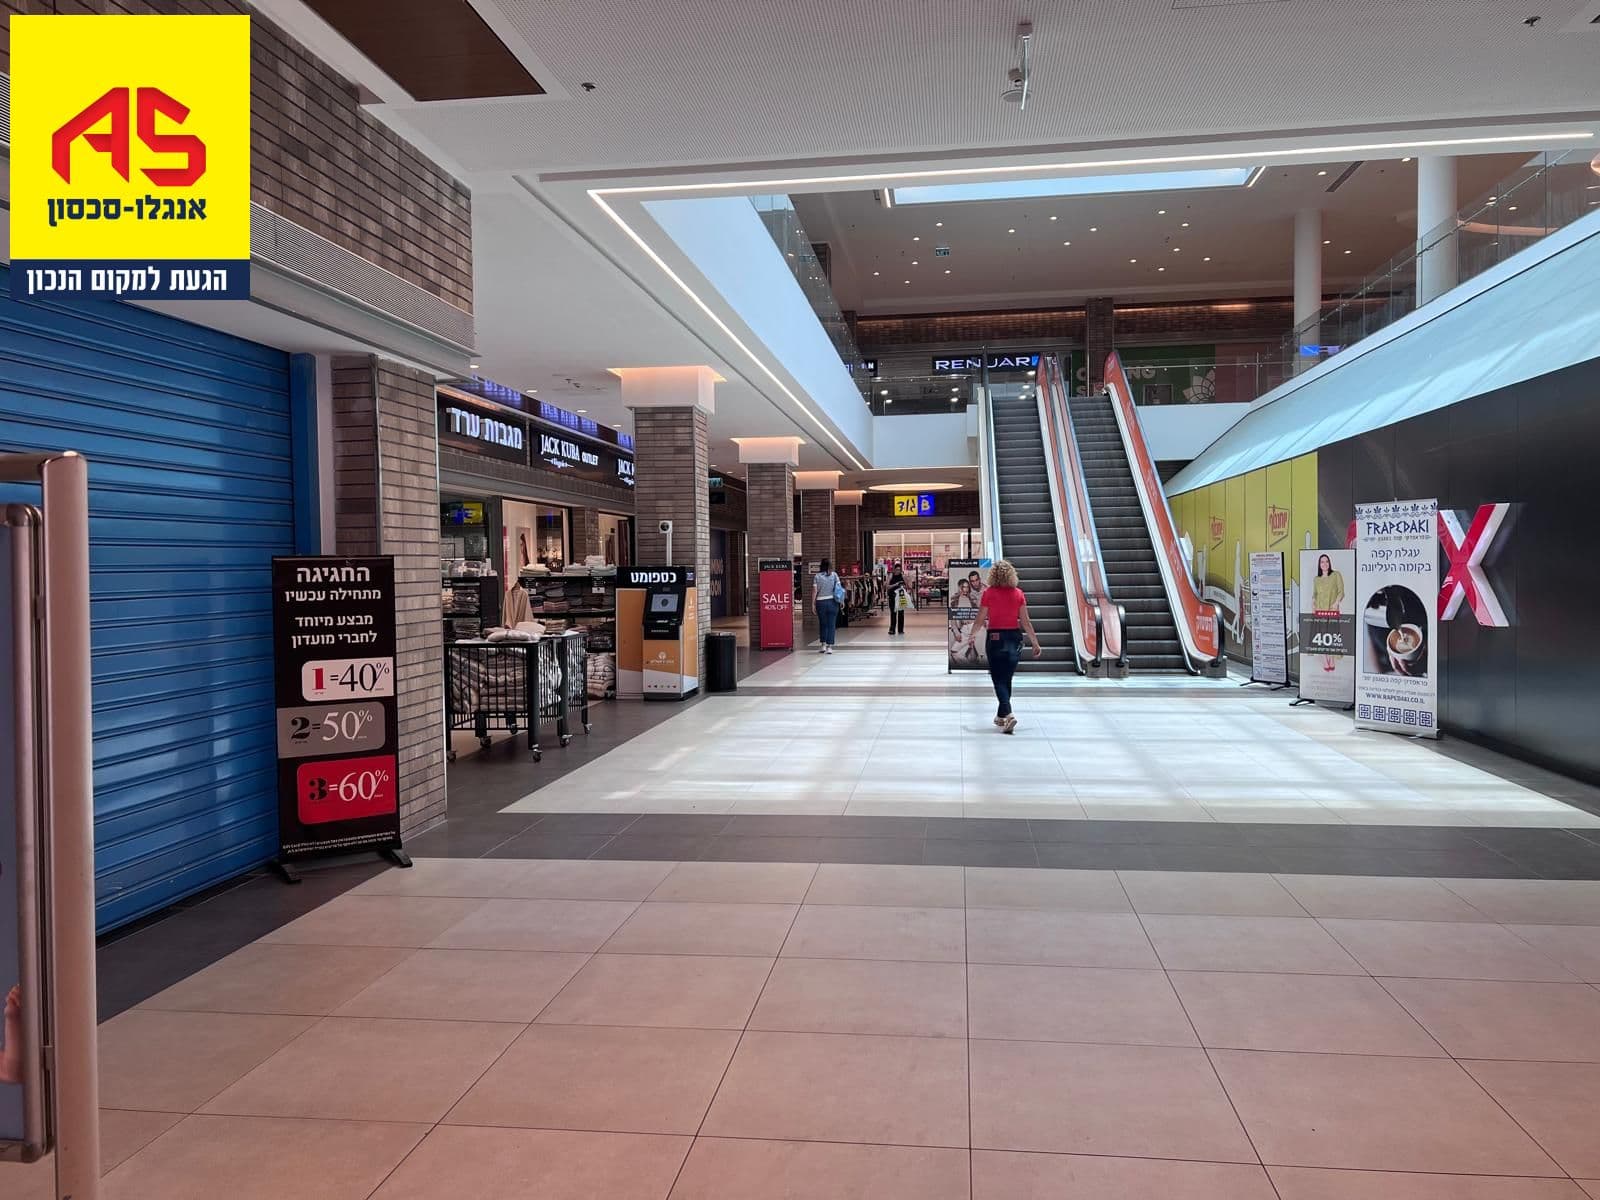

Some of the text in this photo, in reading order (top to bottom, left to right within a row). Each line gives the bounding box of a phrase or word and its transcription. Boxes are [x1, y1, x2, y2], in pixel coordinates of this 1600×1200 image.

[446, 407, 522, 450] מגבות ערד
[541, 434, 560, 455] JACK
[561, 440, 580, 461] KUBA
[1366, 519, 1429, 535] FRAPEDAKI
[1371, 548, 1420, 560] עגלת קפה
[297, 566, 370, 582] החגיגה
[1361, 562, 1432, 574] בקומה העליונה
[630, 572, 677, 584] כספומט
[285, 588, 381, 602] מתחילה עכשיו
[762, 593, 790, 604] SALE
[295, 615, 373, 627] מבצע מיוחד
[291, 630, 377, 648] לחברי מועדון
[1312, 633, 1342, 646] 40%
